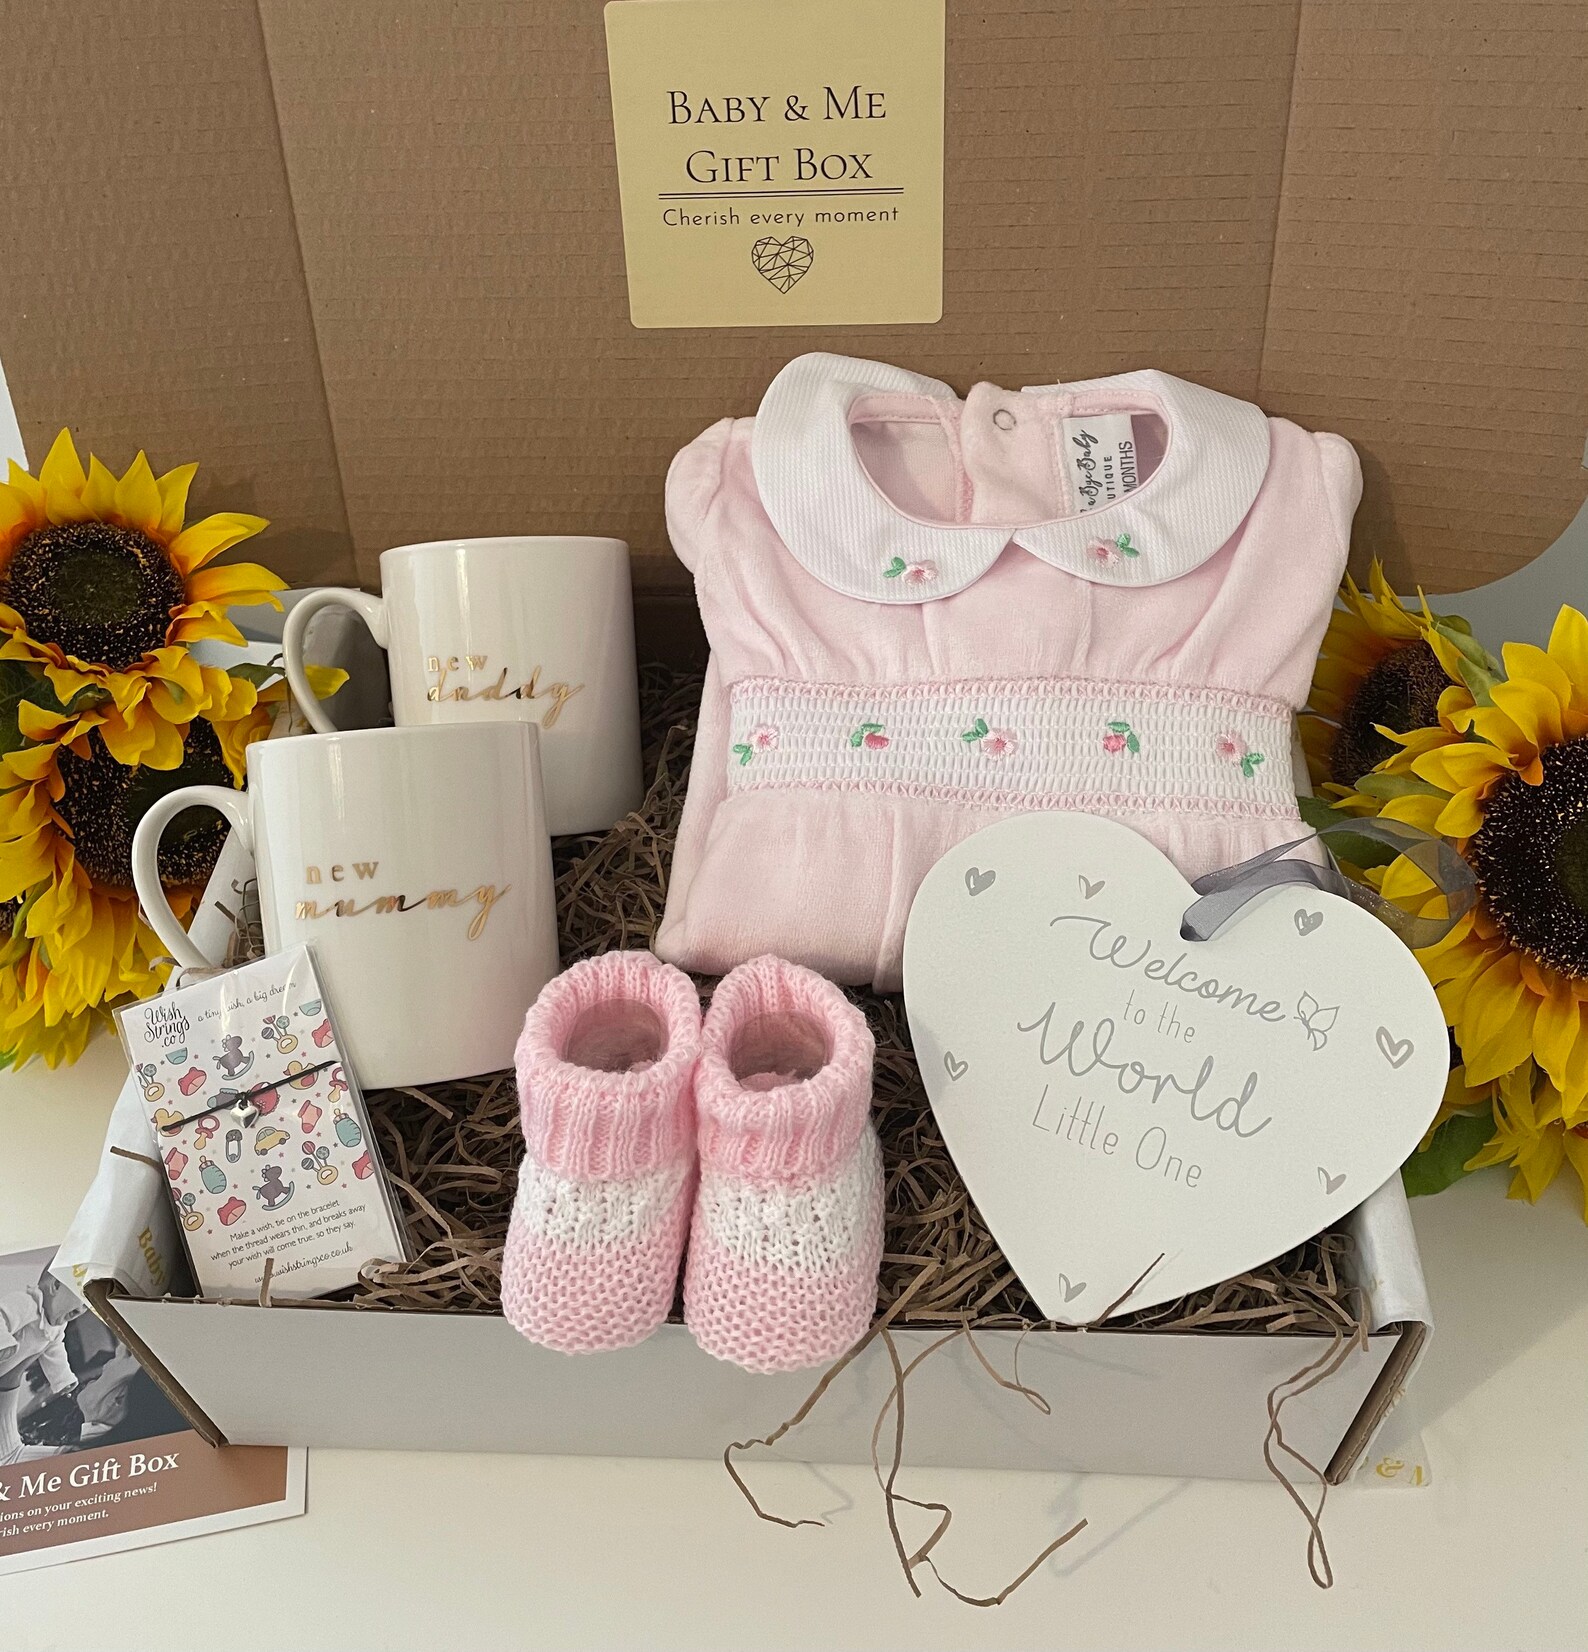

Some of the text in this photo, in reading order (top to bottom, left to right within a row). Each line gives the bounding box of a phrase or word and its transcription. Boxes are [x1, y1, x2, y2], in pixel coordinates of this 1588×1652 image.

[666, 86, 887, 124] BABY & ME
[686, 148, 873, 183] GIFT BOX
[663, 207, 899, 227] Cherish every moment
[427, 654, 488, 672] new
[427, 665, 585, 729] daddy
[306, 861, 379, 884] new
[295, 884, 512, 941] mummy
[1050, 916, 1286, 1022] Welcome
[144, 1001, 182, 1025] Wish
[254, 990, 268, 1003] big
[1123, 989, 1196, 1044] to the
[144, 1016, 190, 1044] Strings
[1017, 1002, 1272, 1138] World
[1032, 1084, 1202, 1188] Little One
[210, 1250, 231, 1261] when
[231, 1243, 245, 1254] the
[245, 1235, 269, 1250] thread
[269, 1229, 291, 1242] wears
[308, 1216, 322, 1229] and
[322, 1209, 347, 1223] breaks
[348, 1203, 366, 1216] away
[229, 1230, 250, 1242] Make
[275, 1217, 286, 1226] tie
[286, 1214, 297, 1223] on
[297, 1209, 310, 1219] the
[310, 1199, 340, 1215] bracelet
[228, 1257, 246, 1270] your
[245, 1251, 262, 1263] wish
[262, 1245, 276, 1257] will
[276, 1239, 297, 1251] come
[315, 1230, 325, 1239] so
[325, 1223, 342, 1236] they
[18, 1471, 62, 1499] Me
[69, 1457, 122, 1488] Gift
[128, 1452, 181, 1478] Box
[27, 1506, 42, 1517] on
[44, 1501, 73, 1517] your
[75, 1490, 121, 1508] exciting
[124, 1482, 158, 1499] news!
[22, 1519, 54, 1533] every
[57, 1509, 110, 1527] moment.
